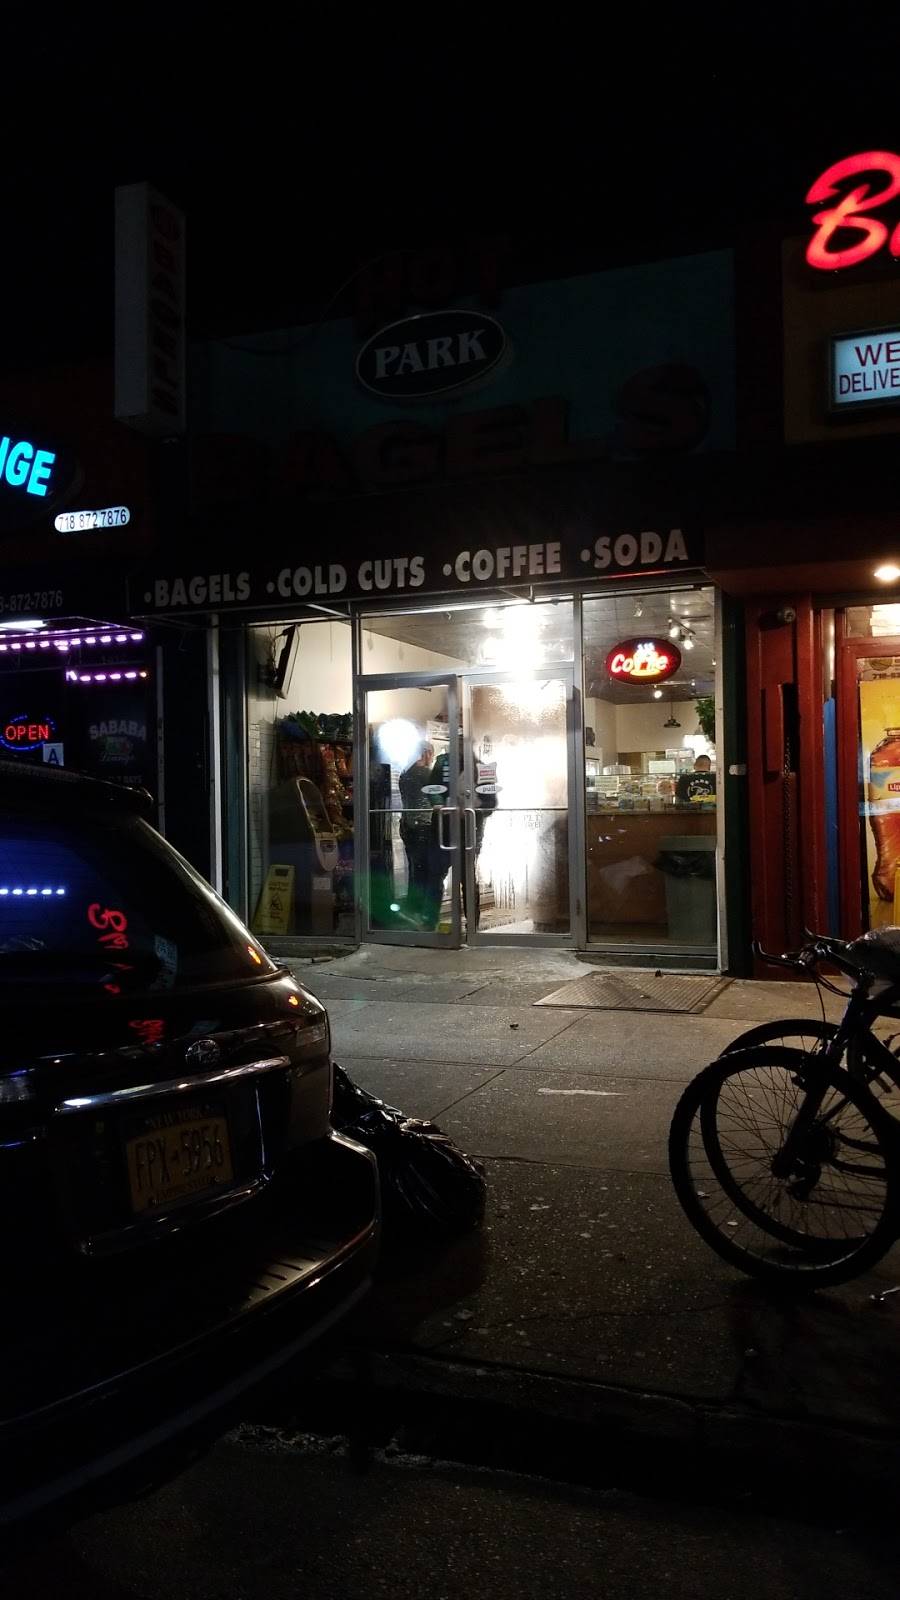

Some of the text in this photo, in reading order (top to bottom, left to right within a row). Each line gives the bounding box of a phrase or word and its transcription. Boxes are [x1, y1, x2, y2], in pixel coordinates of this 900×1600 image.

[805, 151, 900, 271] B
[374, 328, 489, 380] PARK
[58, 508, 127, 530] 718 872 7876
[155, 529, 689, 608] BAGELS COLD CUTS COFFEE SODA
[5, 724, 50, 741] OPEN
[88, 719, 148, 743] SABABA
[48, 748, 60, 765] A
